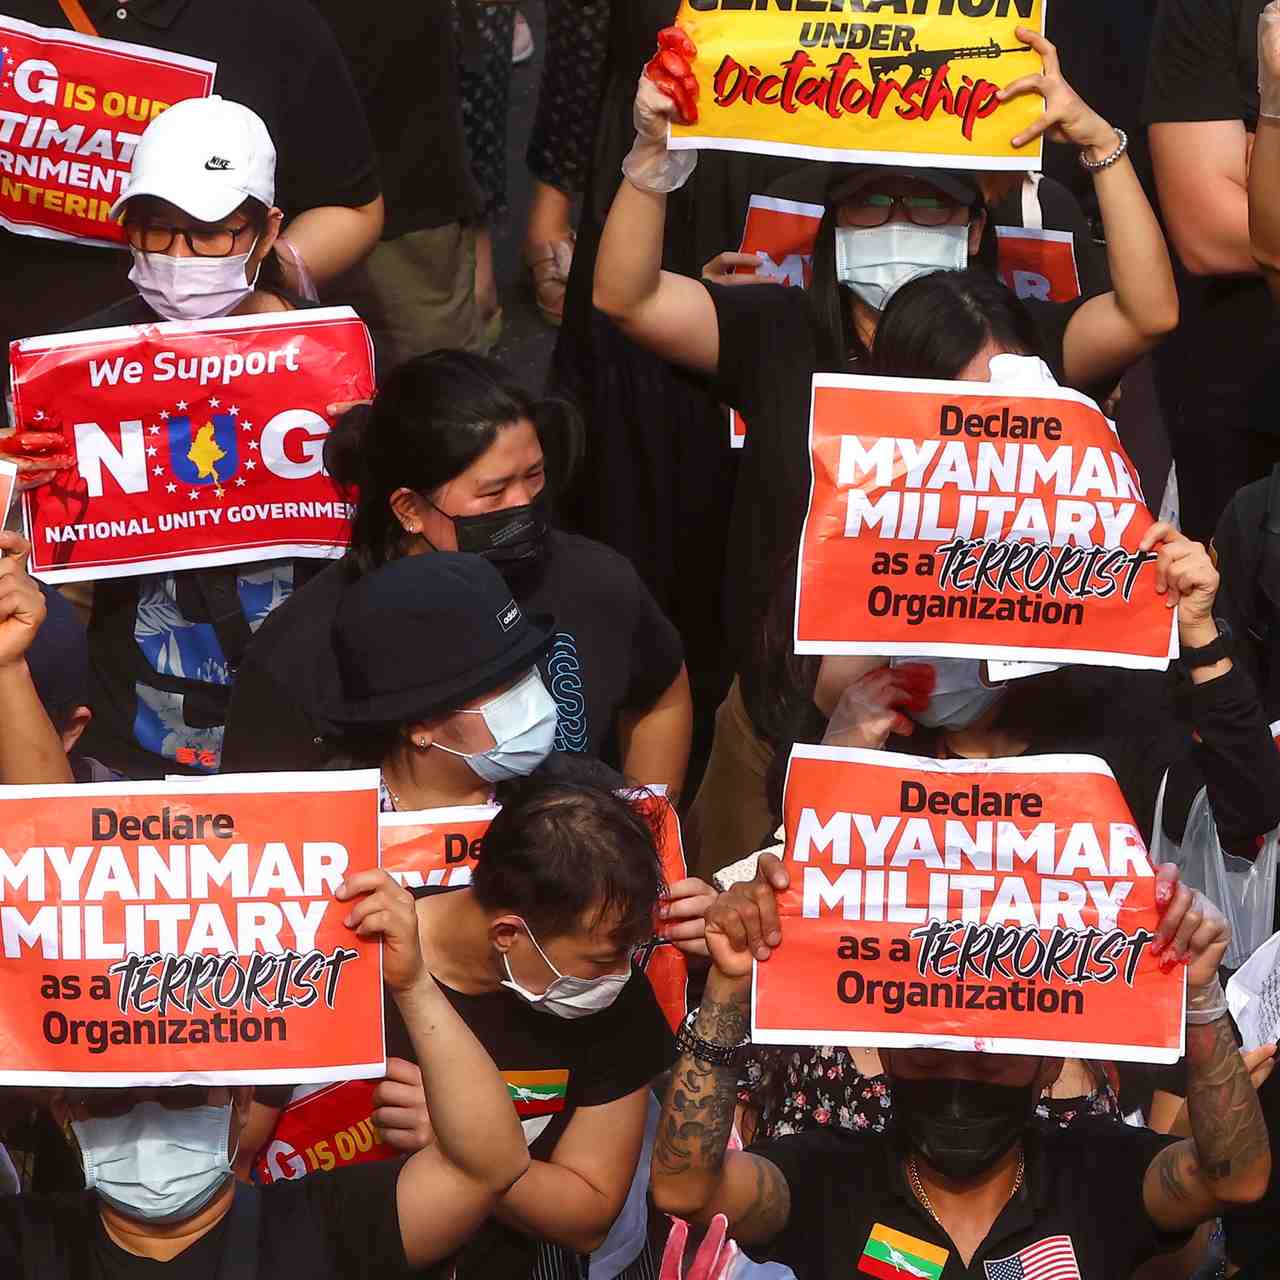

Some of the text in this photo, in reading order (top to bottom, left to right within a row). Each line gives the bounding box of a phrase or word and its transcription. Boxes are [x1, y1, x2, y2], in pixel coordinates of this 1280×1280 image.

[799, 21, 914, 52] UNDER
[64, 83, 98, 111] IS
[713, 51, 1002, 141] Dictatorship
[88, 345, 300, 387] We Support
[940, 404, 1062, 440] Declare
[45, 518, 155, 544] NATIONAL
[159, 509, 223, 533] UNITY
[844, 488, 1136, 549] MILITARY
[872, 539, 1157, 601] as a TERRORIST
[868, 586, 1084, 626] Organization
[900, 781, 1043, 818] Declare
[91, 807, 234, 840] Declare
[792, 807, 1154, 877] MYANMAR
[802, 866, 1134, 931] MILITARY
[0, 901, 329, 961] MILITARY
[837, 917, 1153, 986] as a TERRORIST
[41, 947, 361, 1014] as a TERRORIST
[837, 971, 1084, 1015] Organization
[43, 1010, 286, 1054] Organization
